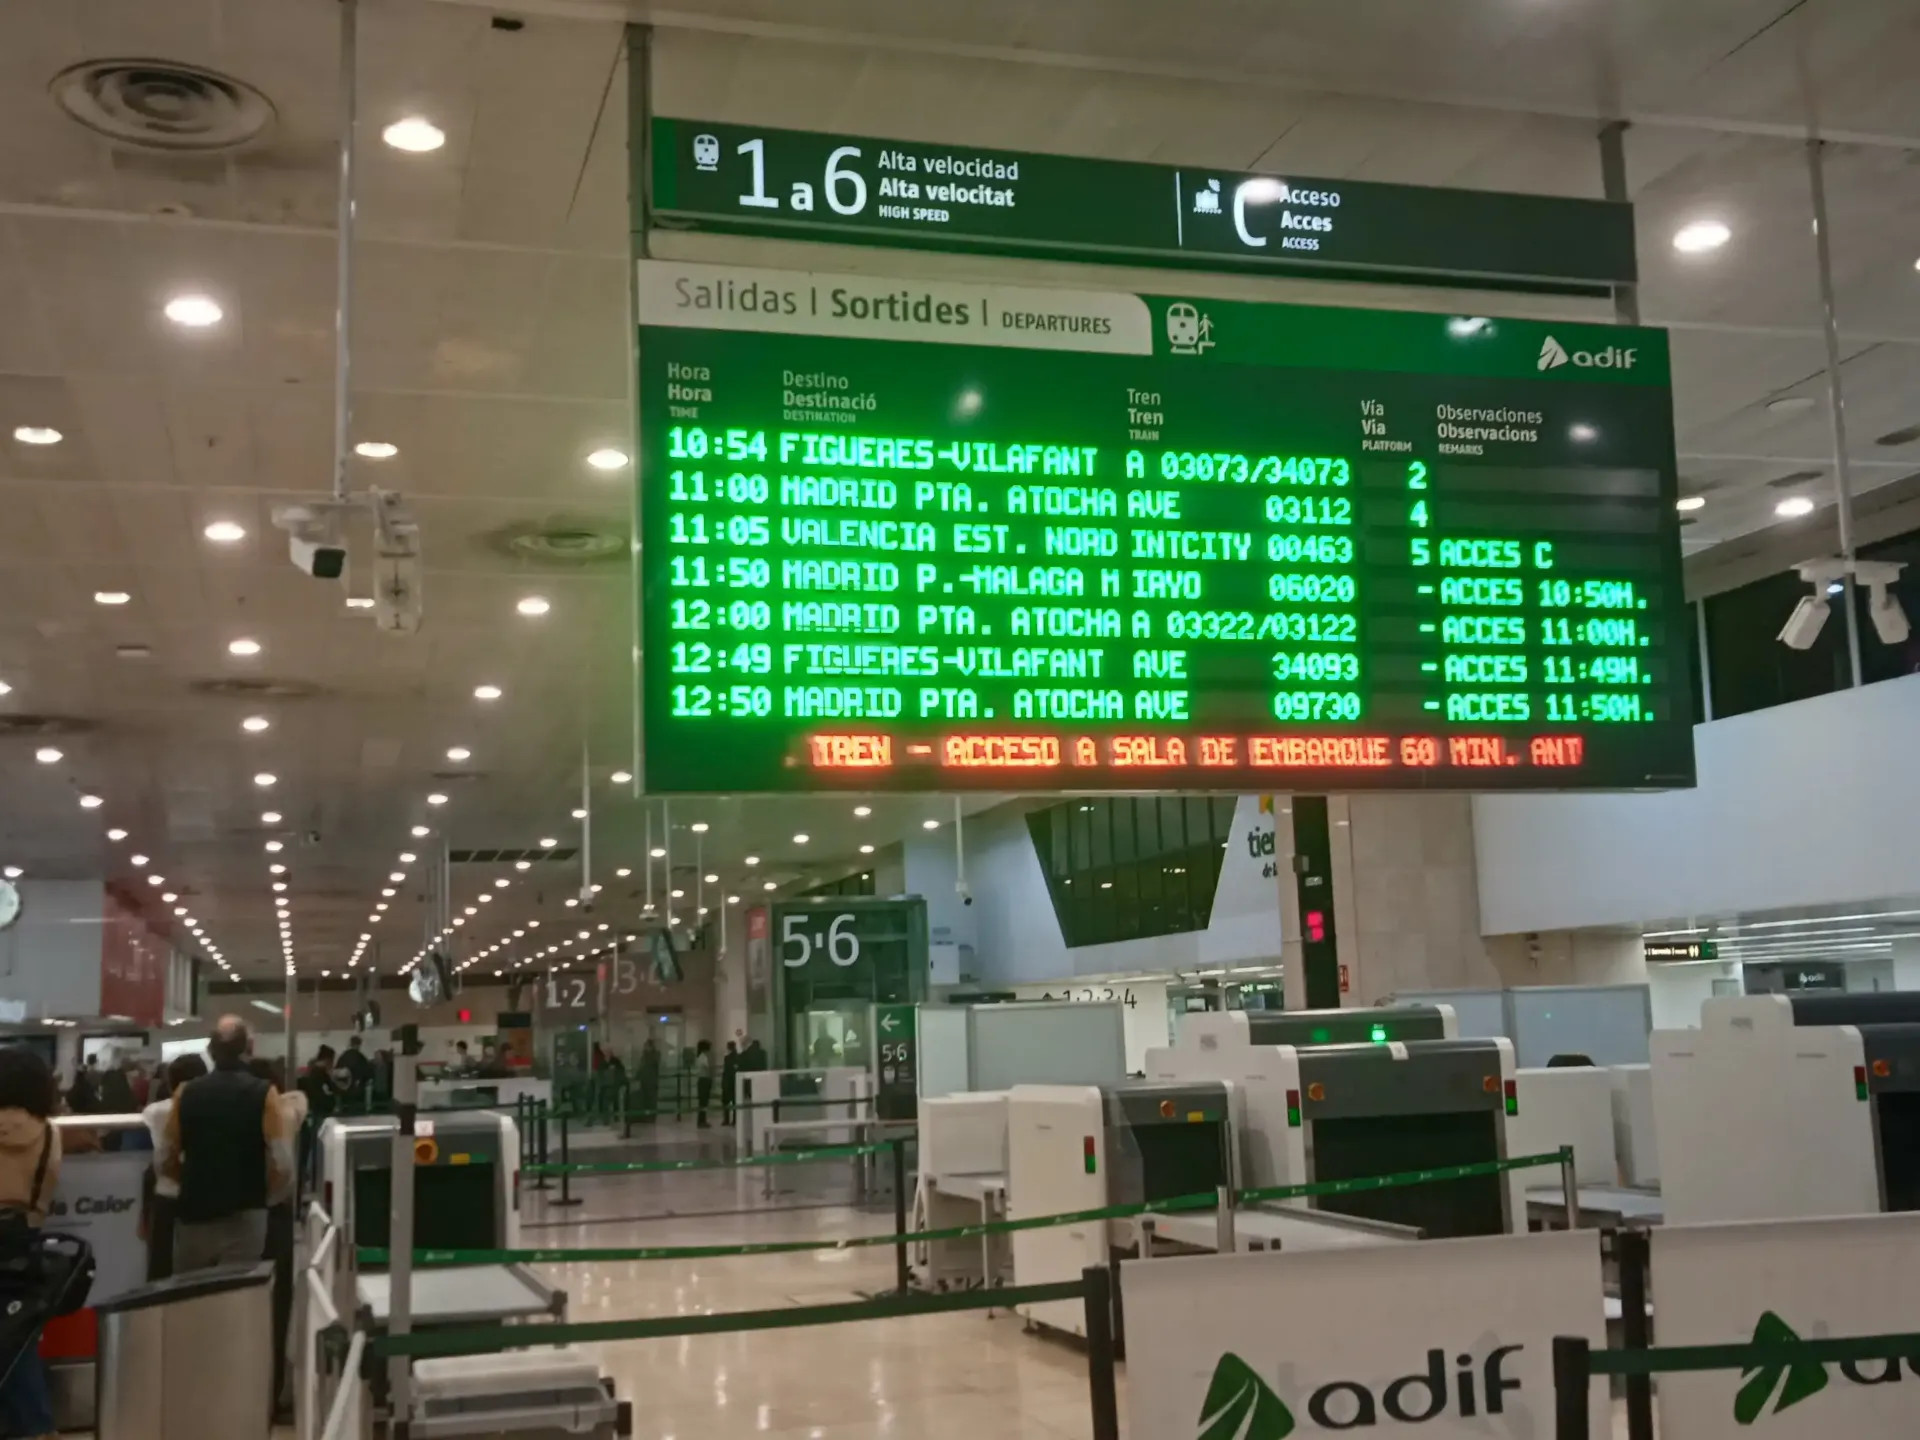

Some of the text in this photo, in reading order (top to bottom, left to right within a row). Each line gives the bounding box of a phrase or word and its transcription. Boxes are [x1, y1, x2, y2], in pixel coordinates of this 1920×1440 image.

[878, 150, 1019, 181] Alta velocidad
[736, 139, 867, 215] 1 a 6
[878, 177, 1015, 207] Alta velocitat
[1279, 184, 1341, 208] Acceso
[879, 205, 950, 223] HIGH SPEED
[1280, 210, 1333, 232] Acces
[1281, 236, 1319, 251] ACCESS
[675, 277, 1112, 335] Salidas Sortides DEPARTURES
[1572, 346, 1639, 370] adif
[668, 363, 710, 381] Hora
[782, 370, 849, 390] Destino
[667, 383, 713, 402] Hora
[782, 390, 877, 412] Destinació
[1127, 388, 1161, 406] Tren
[669, 406, 699, 419] TIME
[783, 410, 856, 424] DESTINATION
[1128, 408, 1163, 426] Tren
[1360, 399, 1385, 416] Vía
[1436, 405, 1544, 425] Observaciones
[1129, 429, 1160, 442] TRAIN
[1437, 424, 1538, 443] Observacions
[1362, 440, 1413, 453] PLATFORM
[1438, 443, 1484, 456] REMARKS
[669, 427, 1427, 490] 10:54 FIGUERES-VILAFANT A 03073/34073 2
[669, 470, 1428, 528] 11:00 MADRID PTA. ATOCHA AVE 03112 4
[670, 512, 1553, 570] 11:05 VALENCIA EST. NORD INTCITY 00463 5 ACCES C
[671, 555, 770, 588] 11:50
[782, 559, 899, 593] MADRID
[917, 562, 1084, 598] P.-MALAGA
[1101, 568, 1120, 597] M
[1133, 570, 1202, 601] IRYO
[1269, 574, 1356, 604] 06020
[1441, 578, 1523, 607] ACCES
[1538, 580, 1649, 610] 10:50H.
[670, 599, 771, 632] 12:00
[782, 601, 900, 635] MADRID
[917, 605, 992, 636] PTA.
[1011, 607, 1121, 639] ATOCHA
[1131, 609, 1151, 640] A
[1166, 610, 1357, 643] 03322/03122
[1442, 617, 1526, 646] ACCES
[1541, 618, 1651, 648] 11:00H.
[671, 642, 772, 675] 12:49
[783, 643, 1104, 678] FIGUERES-VILAFANT
[1133, 650, 1188, 680] AVE
[1272, 653, 1360, 682] 34093
[1444, 656, 1528, 685] ACCES
[1543, 656, 1652, 686] 11:49H.
[671, 684, 772, 718] 12:50
[784, 686, 901, 719] MADRID
[919, 687, 994, 719] PTA.
[1013, 688, 1124, 721] ATOCHA
[1135, 690, 1189, 721] AVE
[1274, 691, 1361, 721] 09730
[1447, 694, 1531, 722] ACCES
[1545, 694, 1655, 723] 11:50H.
[812, 734, 893, 768] TREN
[945, 735, 1060, 768] ACCESO
[1075, 735, 1098, 767] A
[1111, 737, 1188, 767] SALA
[1200, 737, 1238, 767] DE
[1249, 737, 1392, 767] EMBARQUE
[1400, 737, 1435, 766] 60
[1449, 737, 1520, 767] MIN.
[1531, 736, 1583, 766] ANT
[1306, 1344, 1525, 1430] adif
